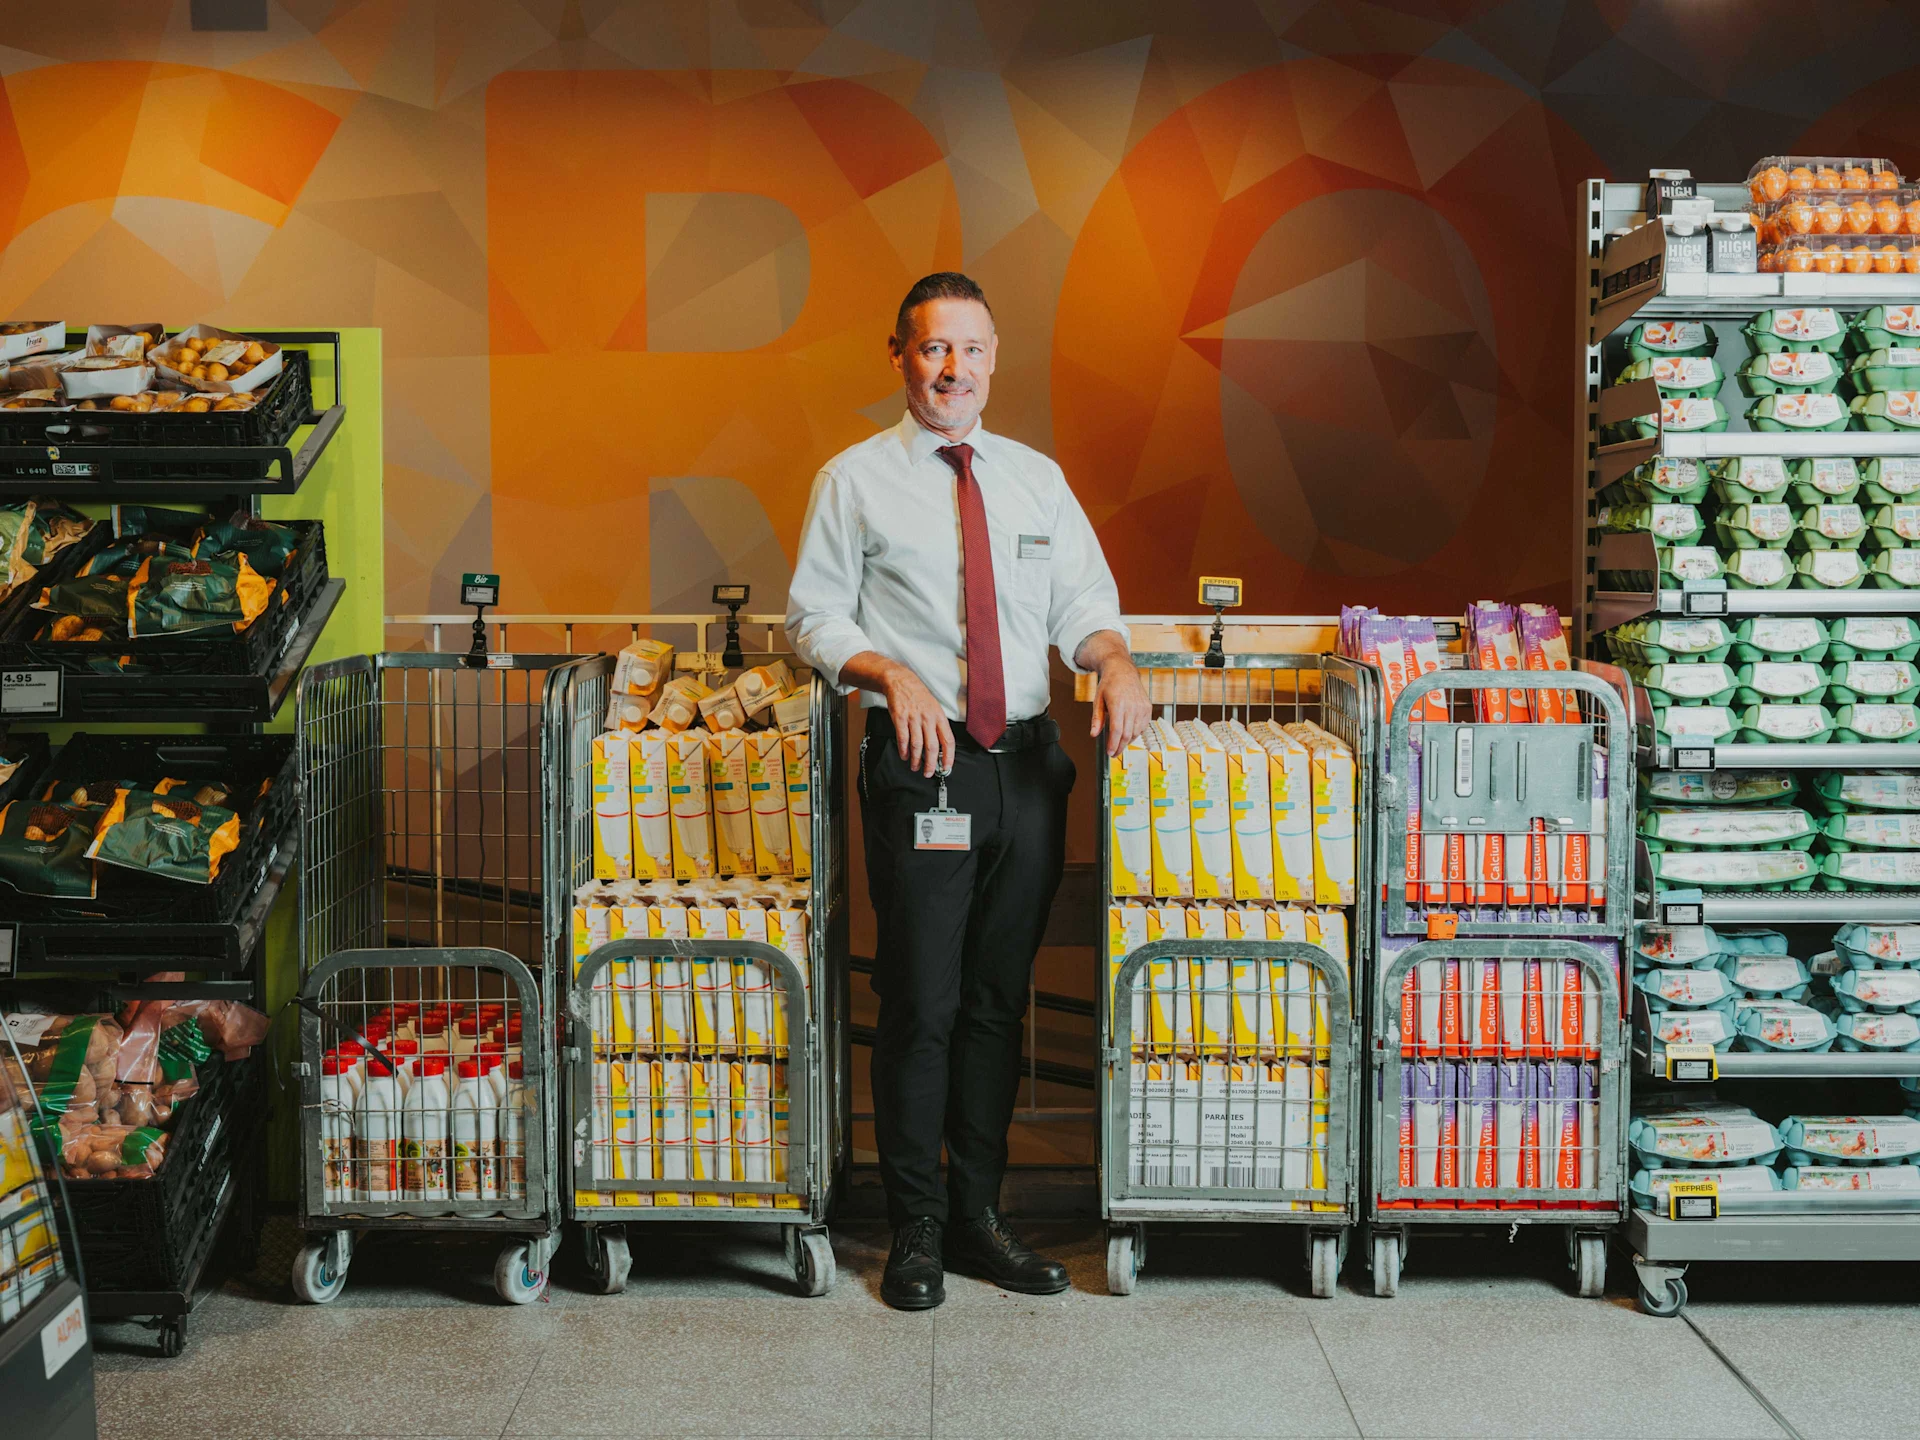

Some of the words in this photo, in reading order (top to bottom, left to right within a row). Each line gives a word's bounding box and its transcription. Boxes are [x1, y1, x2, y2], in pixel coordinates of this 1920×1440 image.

[1661, 186, 1692, 198] HIGH
[1668, 244, 1702, 257] HIGH
[1718, 240, 1751, 253] HIGH
[29, 467, 47, 475] 6410
[1204, 578, 1238, 586] TIEFPREIS
[1529, 633, 1540, 651] Milk
[1405, 654, 1413, 671] Vita
[4, 673, 32, 683] 4.95
[1407, 784, 1418, 806] Milk
[1408, 811, 1418, 833] Vita
[1408, 834, 1418, 879] Calcium
[1450, 834, 1459, 880] Calcium
[1490, 835, 1500, 881] Calcium
[1533, 835, 1542, 881] Calcium
[1571, 836, 1582, 882] Calcium
[1403, 968, 1414, 991] Vita
[1446, 967, 1454, 990] Vita
[1486, 967, 1495, 990] Vita
[1567, 968, 1576, 991] Vita
[1403, 991, 1414, 1036] Calcium
[1445, 990, 1455, 1035] Calcium
[1487, 990, 1496, 1035] Calcium
[1529, 990, 1538, 1035] Calcium
[1569, 991, 1579, 1036] Calcium
[1400, 1095, 1408, 1116] Milk
[1482, 1095, 1491, 1116] Milk
[1563, 1095, 1573, 1116] Milk
[1400, 1122, 1409, 1143] Vita
[1482, 1122, 1492, 1143] Vita
[1564, 1122, 1574, 1143] Vita
[1400, 1143, 1410, 1188] Calcium
[1482, 1143, 1493, 1188] Calcium
[1564, 1143, 1575, 1188] Calcium
[1674, 1184, 1714, 1192] TIEFPREIS
